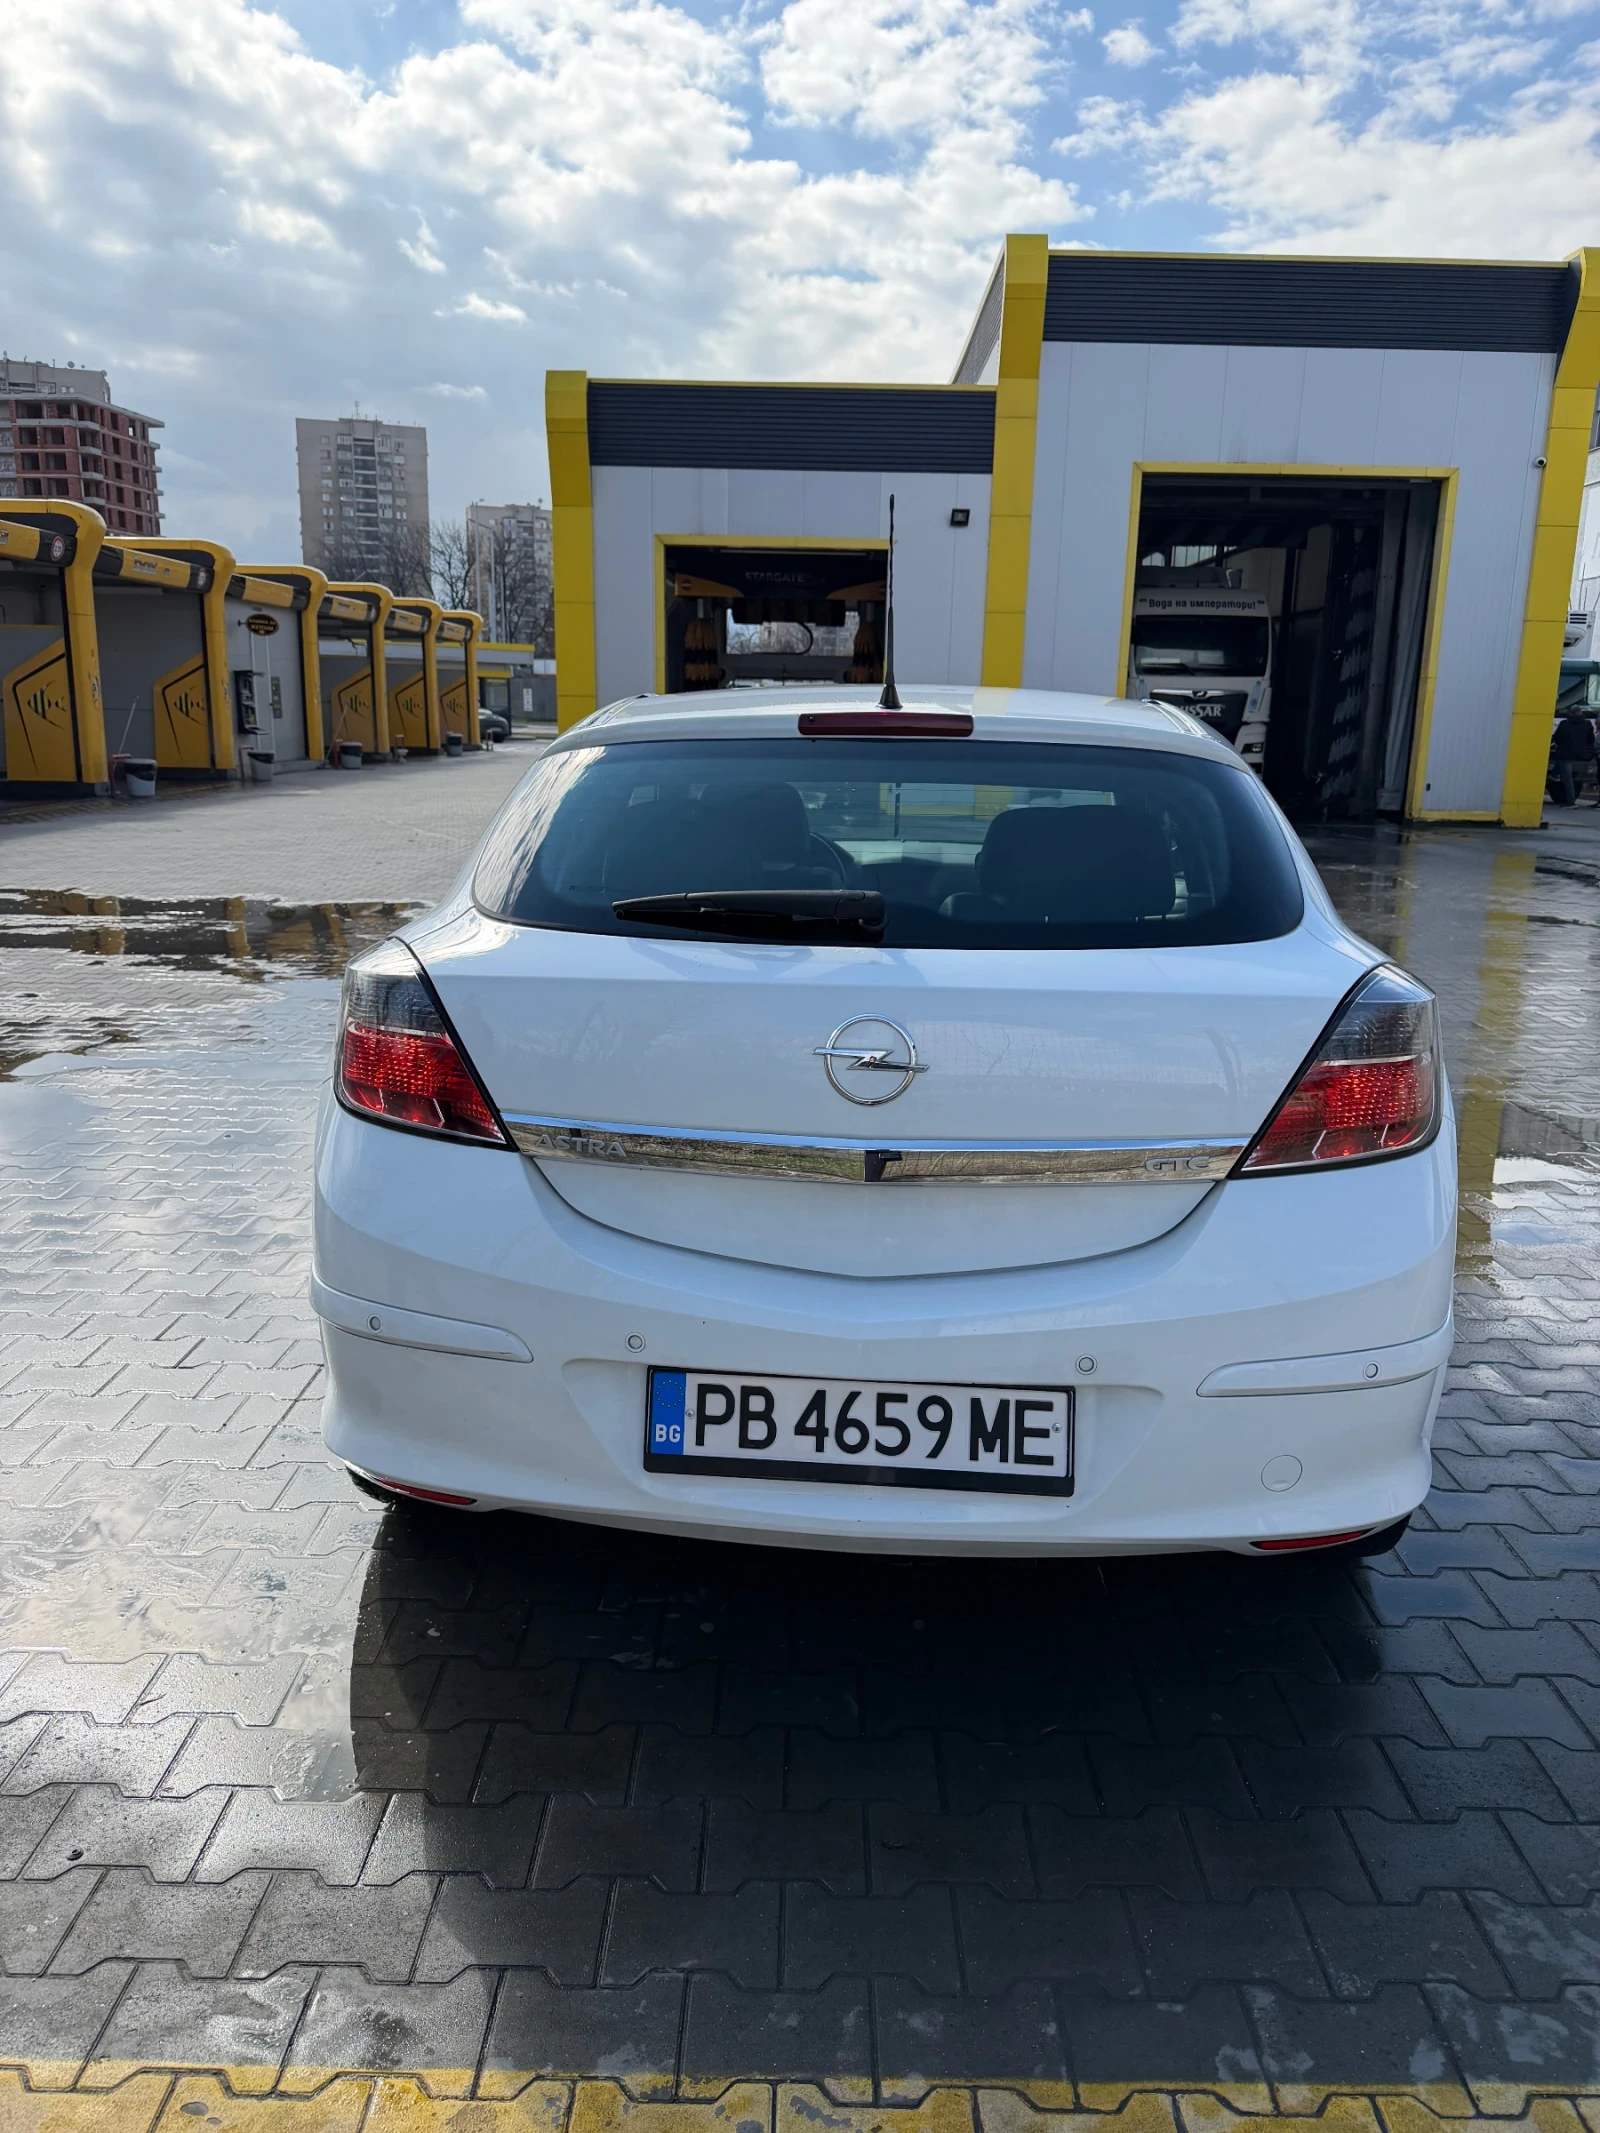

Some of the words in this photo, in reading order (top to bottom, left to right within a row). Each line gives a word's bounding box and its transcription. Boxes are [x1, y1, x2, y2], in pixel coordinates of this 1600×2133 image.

[744, 571, 805, 584] STARGATE
[1175, 600, 1187, 608] на
[535, 1133, 627, 1157] ASTRA
[1144, 1156, 1210, 1172] GTC
[655, 1423, 681, 1444] BG
[694, 1383, 777, 1450] PB
[794, 1389, 952, 1459] 4659
[969, 1396, 1055, 1466] ME
